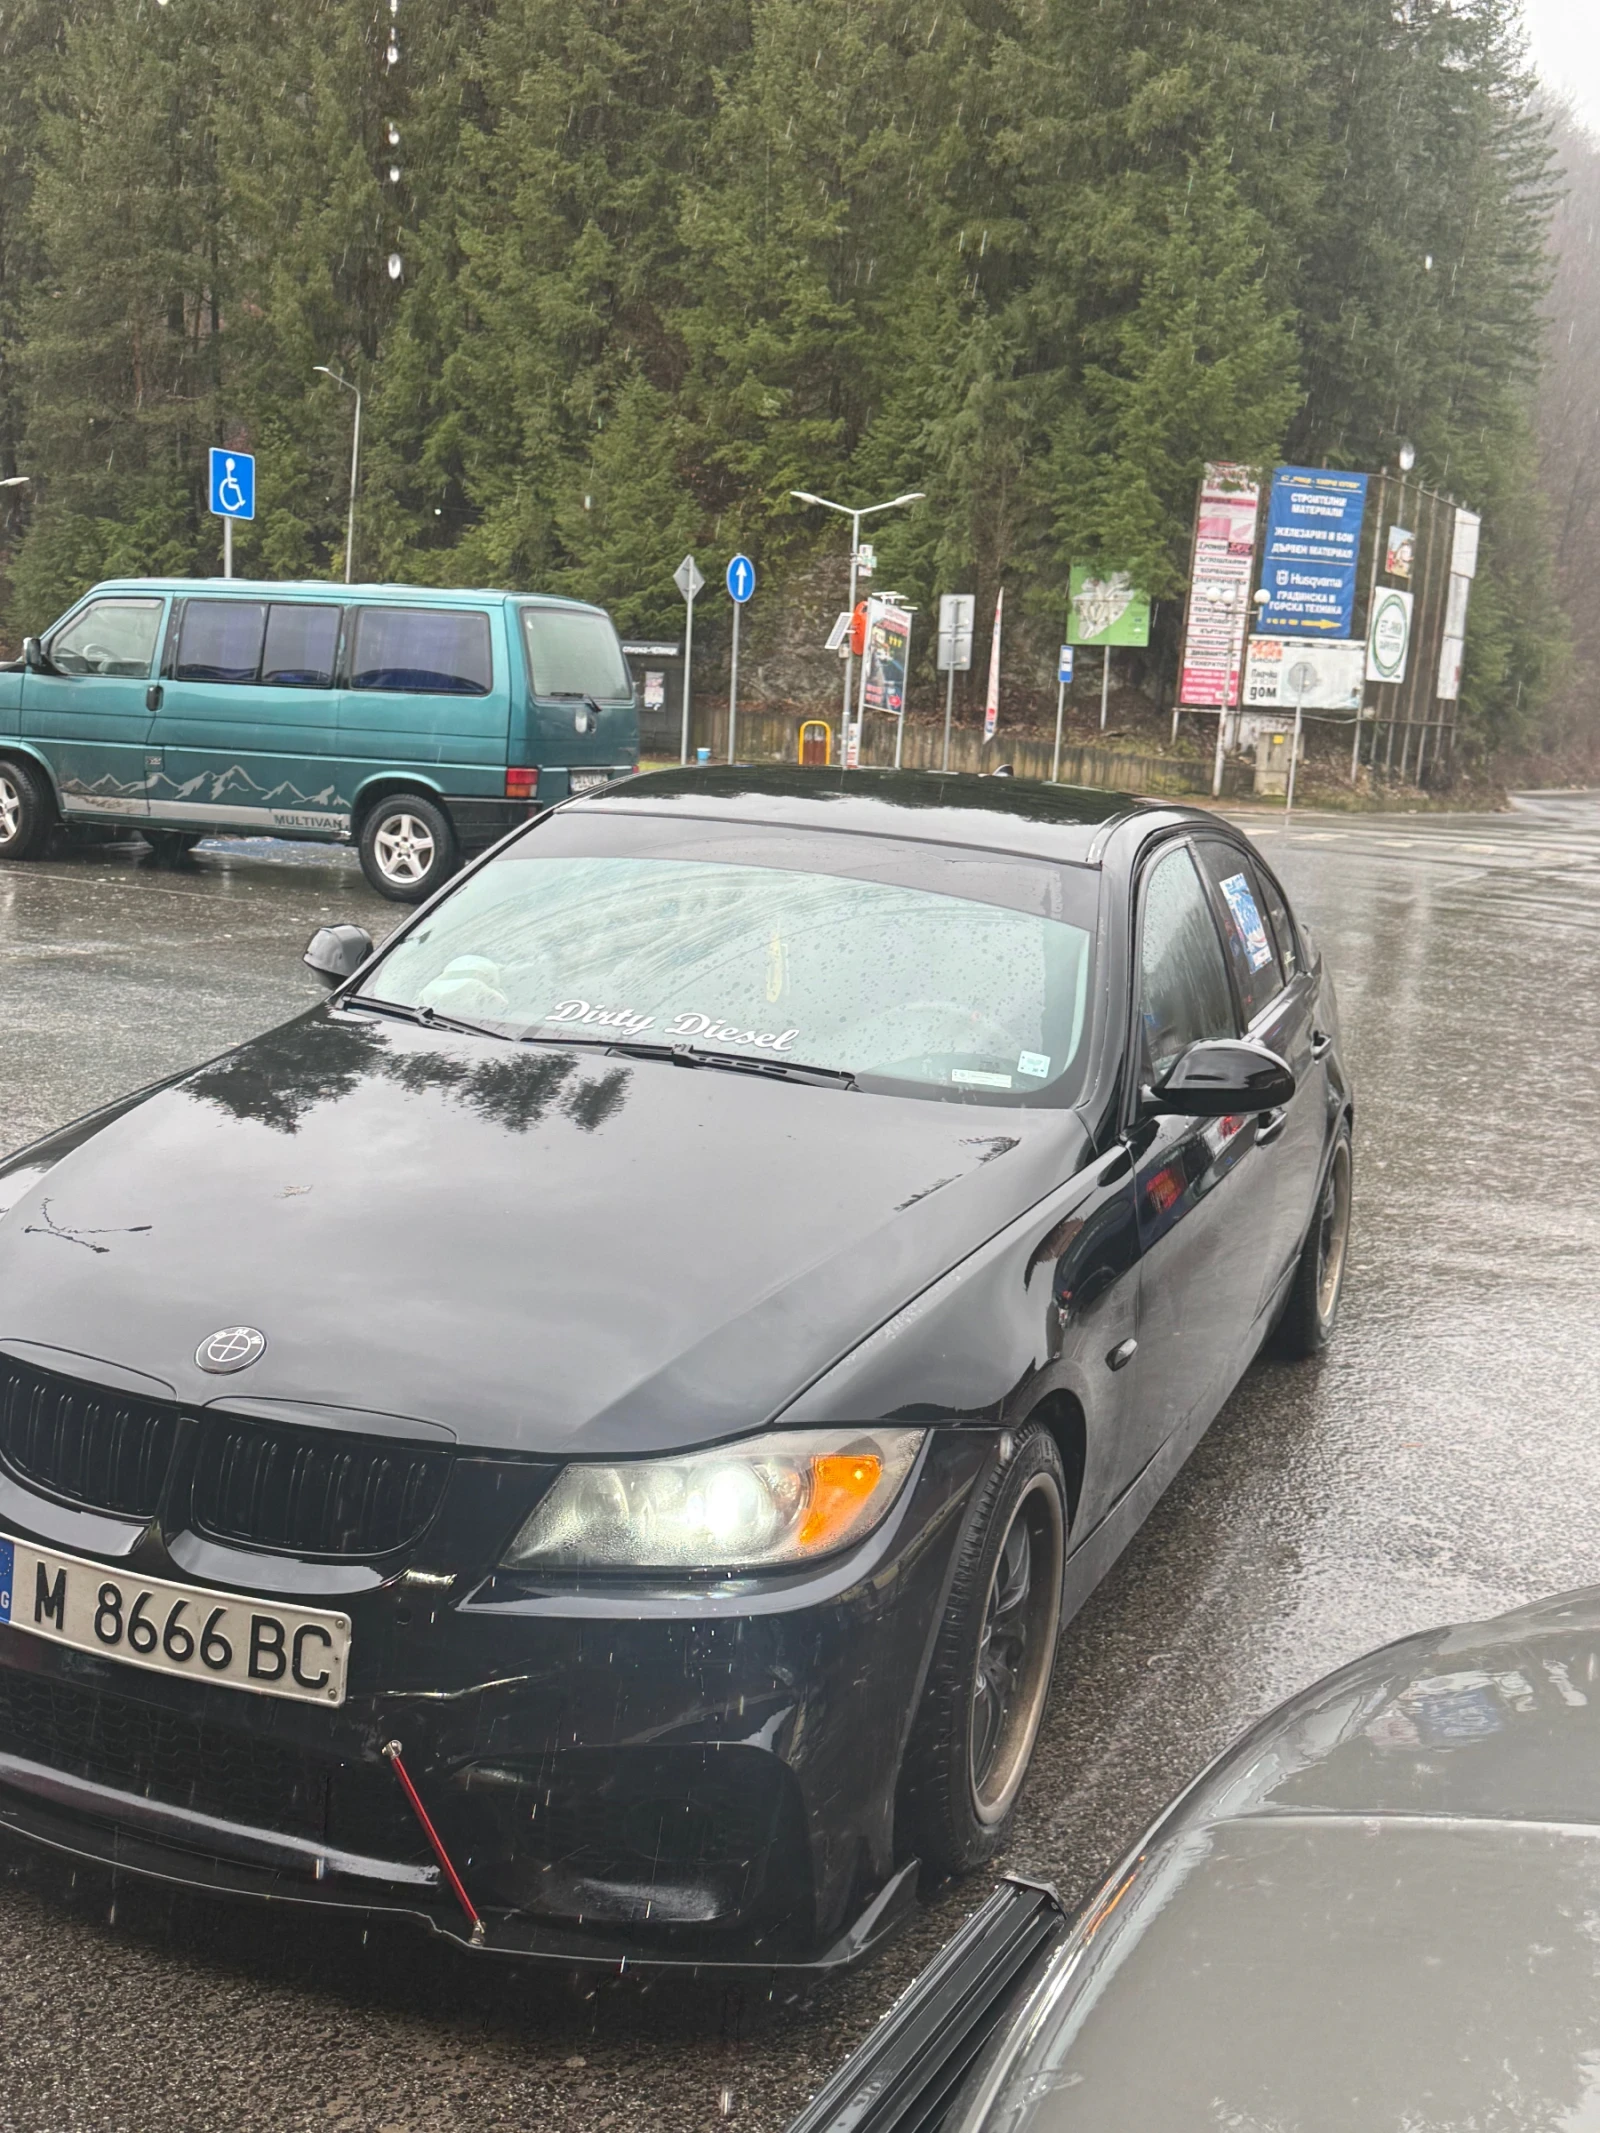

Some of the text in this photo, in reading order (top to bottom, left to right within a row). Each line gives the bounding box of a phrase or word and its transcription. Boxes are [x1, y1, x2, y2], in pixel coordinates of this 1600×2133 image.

[1291, 493, 1347, 507] СТРОИТЕЛНИ
[1291, 504, 1344, 517] МАТЕРИАЛИ
[1274, 527, 1354, 543] ЖЕЛЕЗАРИЯ И БОИ
[1271, 542, 1353, 558] ДЪРВЕН МАТЕРИАЛ
[1290, 573, 1343, 589] Husqvarna
[1276, 591, 1336, 604] ГРАДИНСКА И
[1268, 601, 1342, 615] ГОРСКА ТЕХНИКА
[273, 814, 342, 831] MULTIVAN
[545, 1000, 800, 1051] Dirty Diesel
[34, 1561, 67, 1631] M
[94, 1582, 233, 1670] 8666
[248, 1614, 332, 1689] BC
